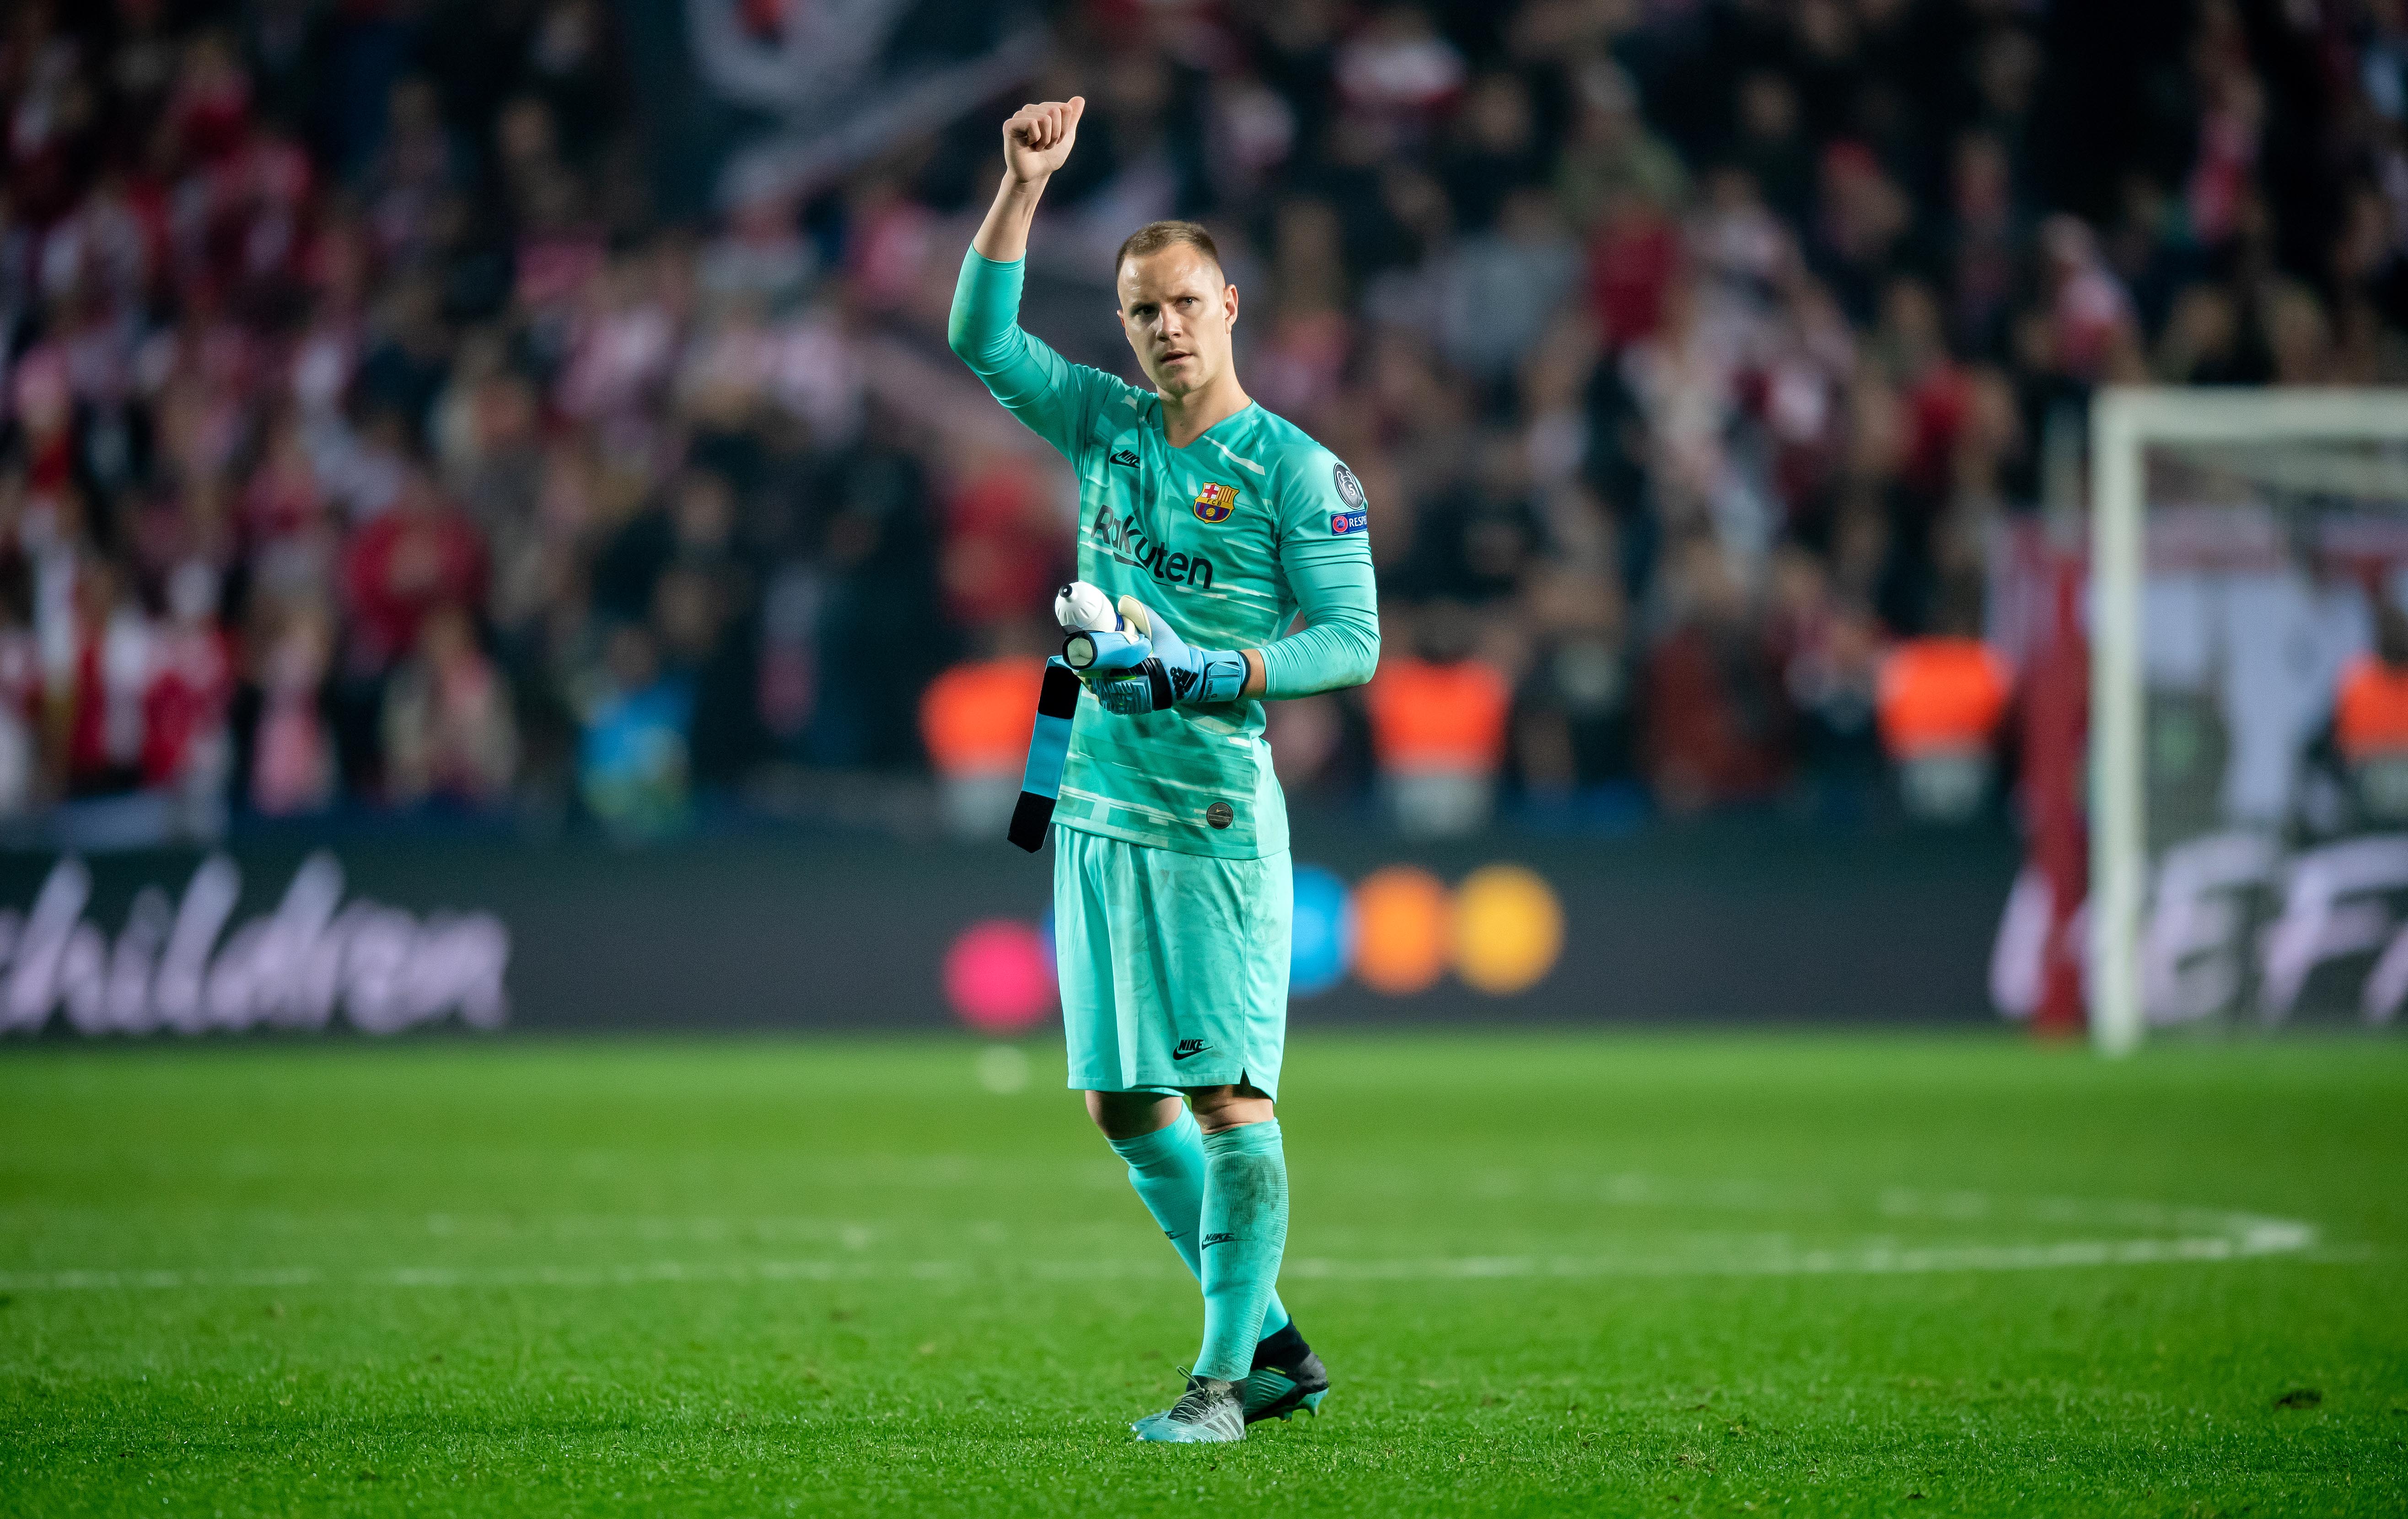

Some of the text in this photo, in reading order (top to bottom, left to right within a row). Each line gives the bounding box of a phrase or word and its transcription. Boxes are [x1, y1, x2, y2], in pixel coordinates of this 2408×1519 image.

[1118, 450, 1140, 465] NIKE
[1348, 484, 1355, 495] 5
[1349, 515, 1367, 527] RESPE
[1091, 504, 1213, 590] Rakuten
[1990, 833, 2408, 1025] UEF
[0, 848, 509, 1033] hildren
[1178, 1039, 1204, 1051] NIKE
[1204, 1233, 1235, 1242] NIKE
